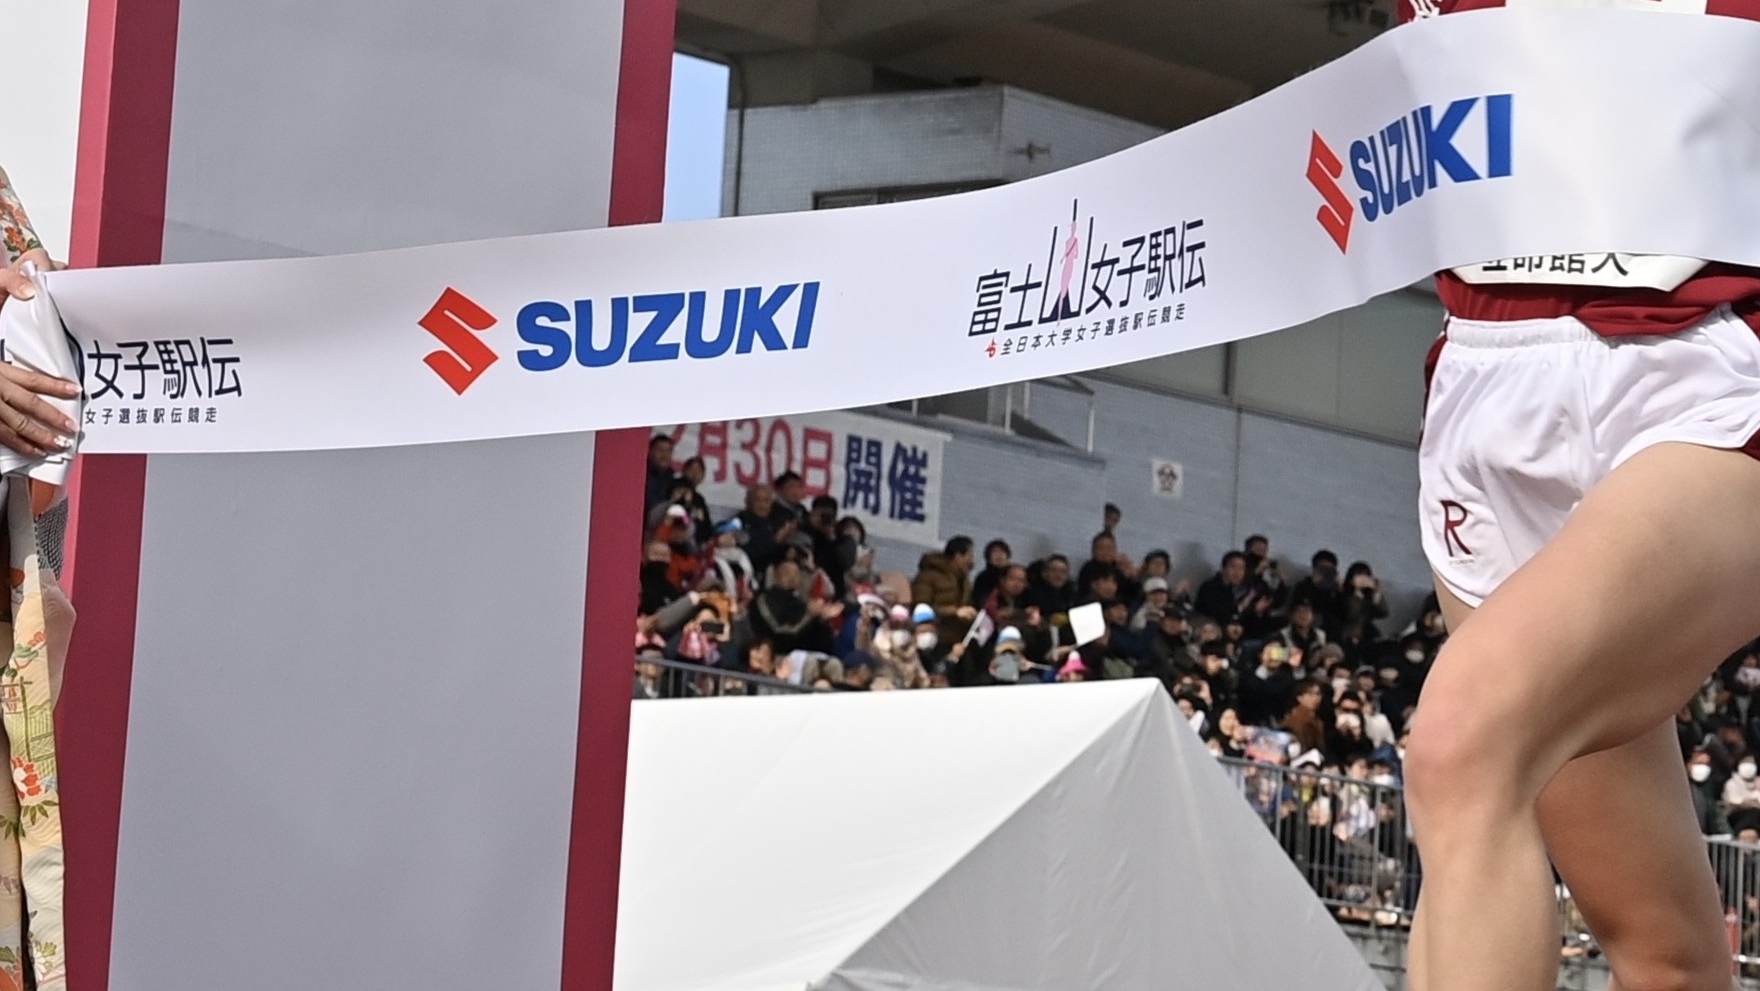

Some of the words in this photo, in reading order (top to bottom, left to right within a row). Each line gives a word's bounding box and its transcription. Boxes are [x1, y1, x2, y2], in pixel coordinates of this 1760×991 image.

[1350, 93, 1515, 223] SUZUKI
[968, 197, 1206, 337] 富士山女子駅伝
[516, 280, 821, 372] SUZUKI
[1439, 499, 1473, 557] R
